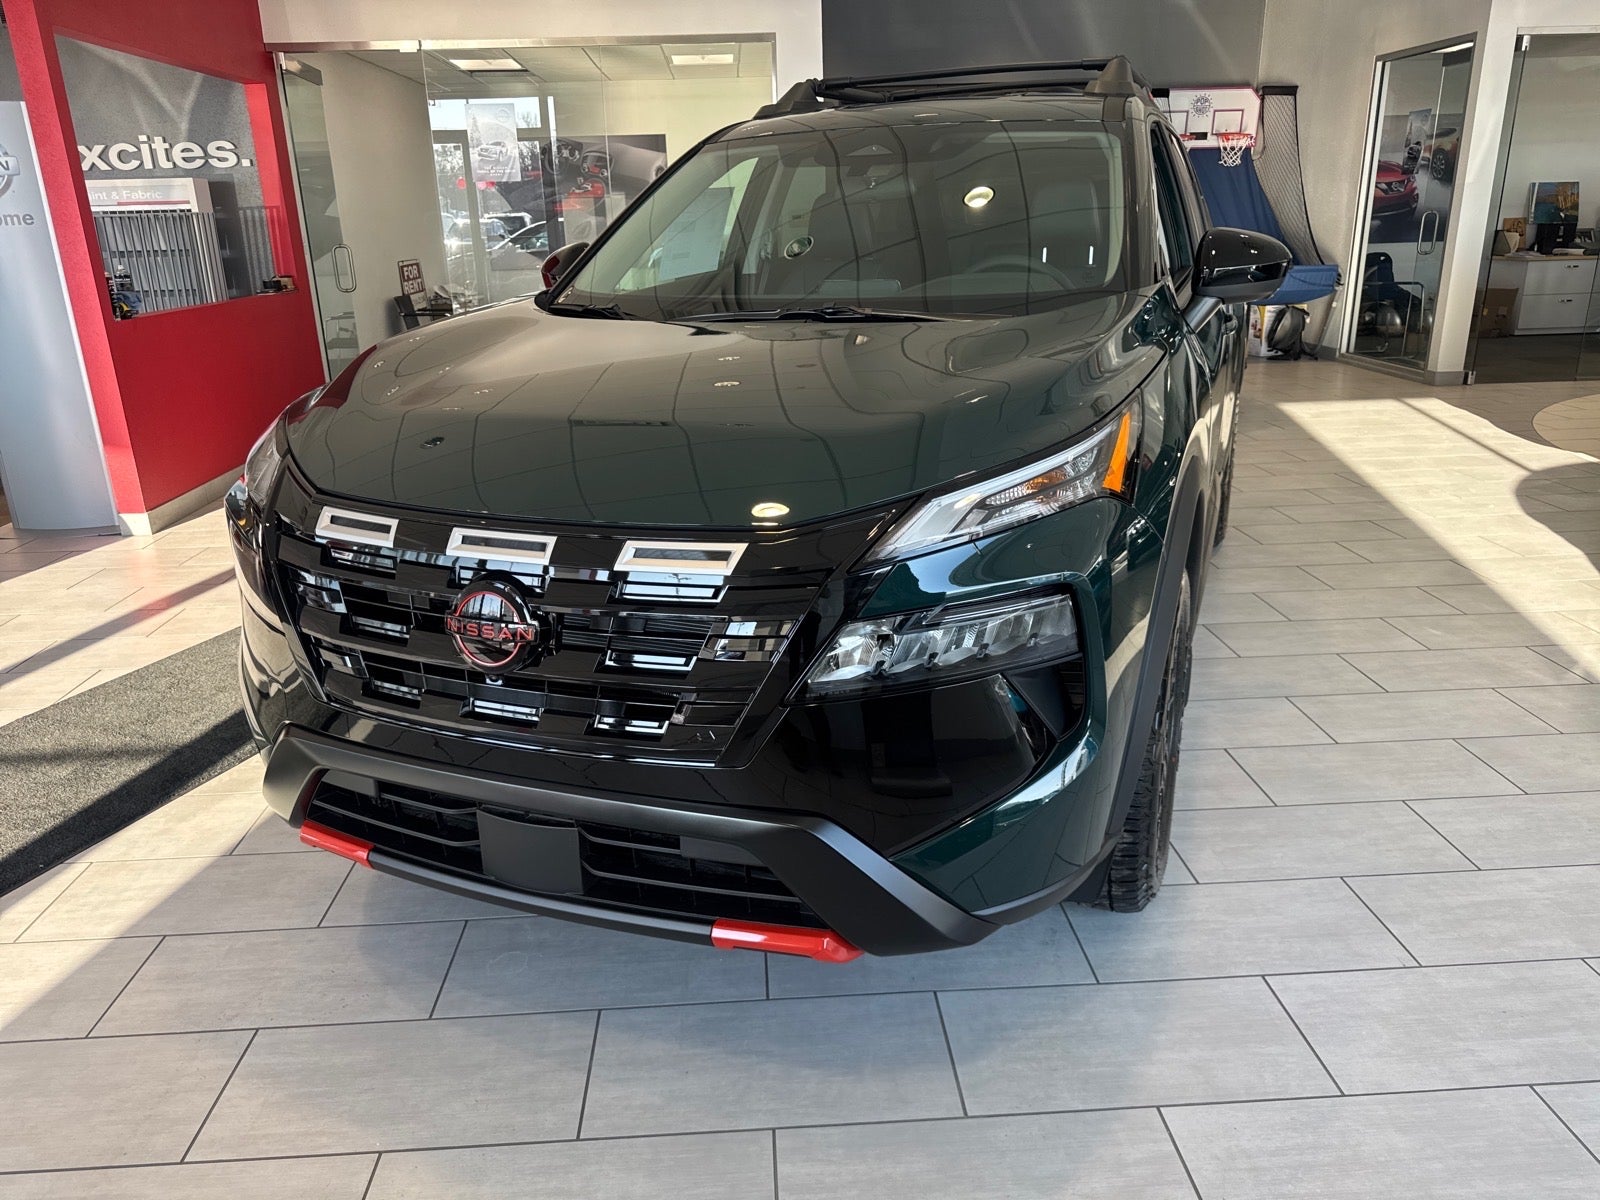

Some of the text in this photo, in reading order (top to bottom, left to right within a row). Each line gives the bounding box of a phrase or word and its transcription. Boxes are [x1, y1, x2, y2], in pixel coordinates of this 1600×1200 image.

[77, 134, 252, 171] xcites.
[88, 190, 162, 200] int & Fabric
[0, 213, 35, 226] ome
[403, 265, 419, 279] FOR
[404, 279, 423, 294] RENT
[447, 618, 534, 640] NISSAN
